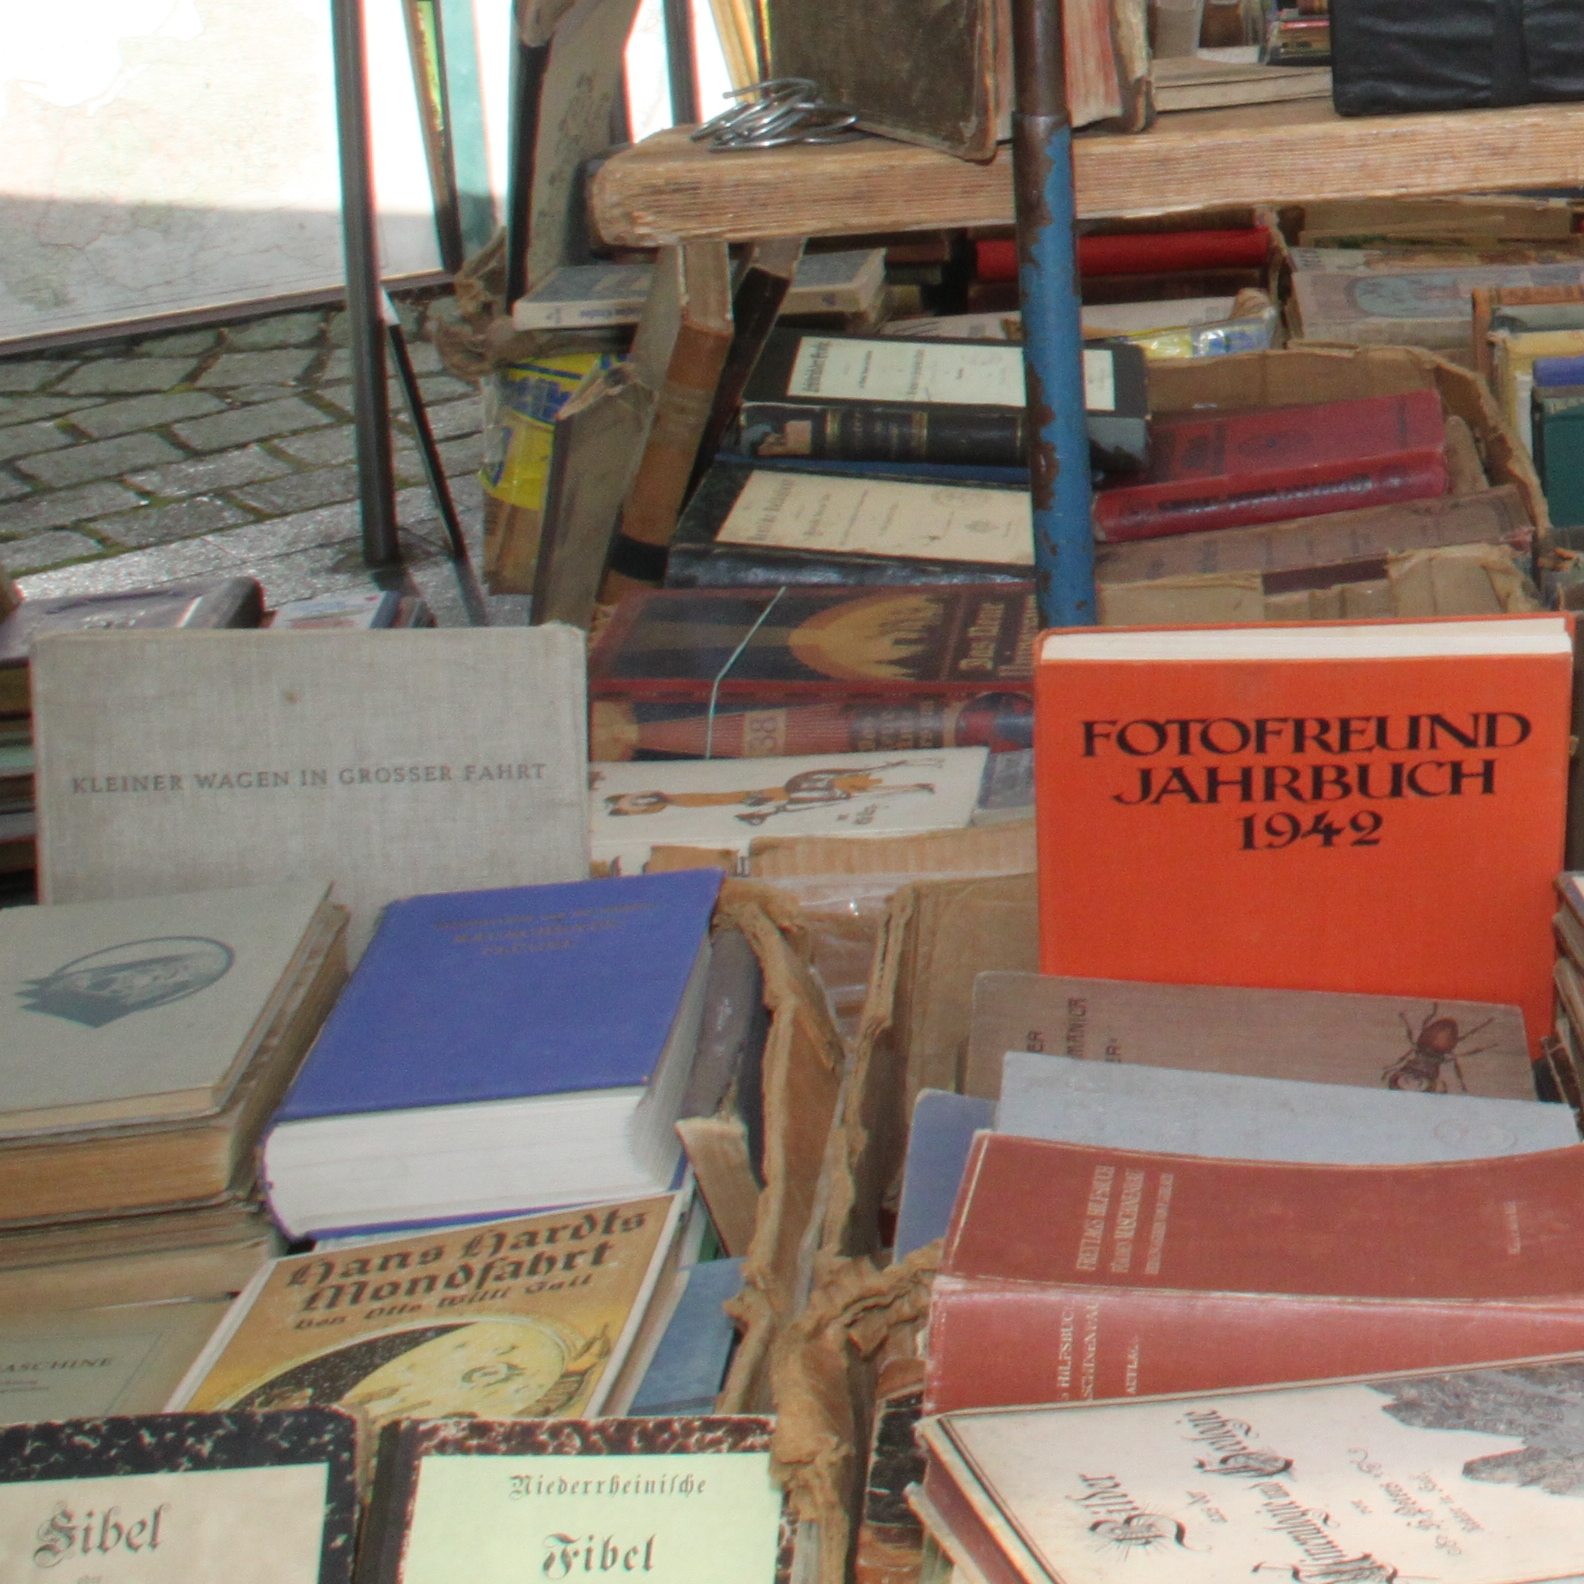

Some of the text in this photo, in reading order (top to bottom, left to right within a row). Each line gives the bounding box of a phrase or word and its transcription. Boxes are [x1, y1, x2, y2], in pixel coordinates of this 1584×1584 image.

[1080, 711, 1533, 759] FOTOFREUND
[72, 762, 548, 795] KLEINER WAGEN IN GROSSER FAHRT
[1112, 758, 1498, 807] JAHRBUCH
[1237, 810, 1384, 852] 1942
[286, 1208, 650, 1289] Hans Hardts
[300, 1241, 616, 1313] Mondfahrt
[0, 1353, 114, 1377] ASCHINE
[34, 1500, 171, 1570] Fibel
[541, 1533, 656, 1580] Fibel
